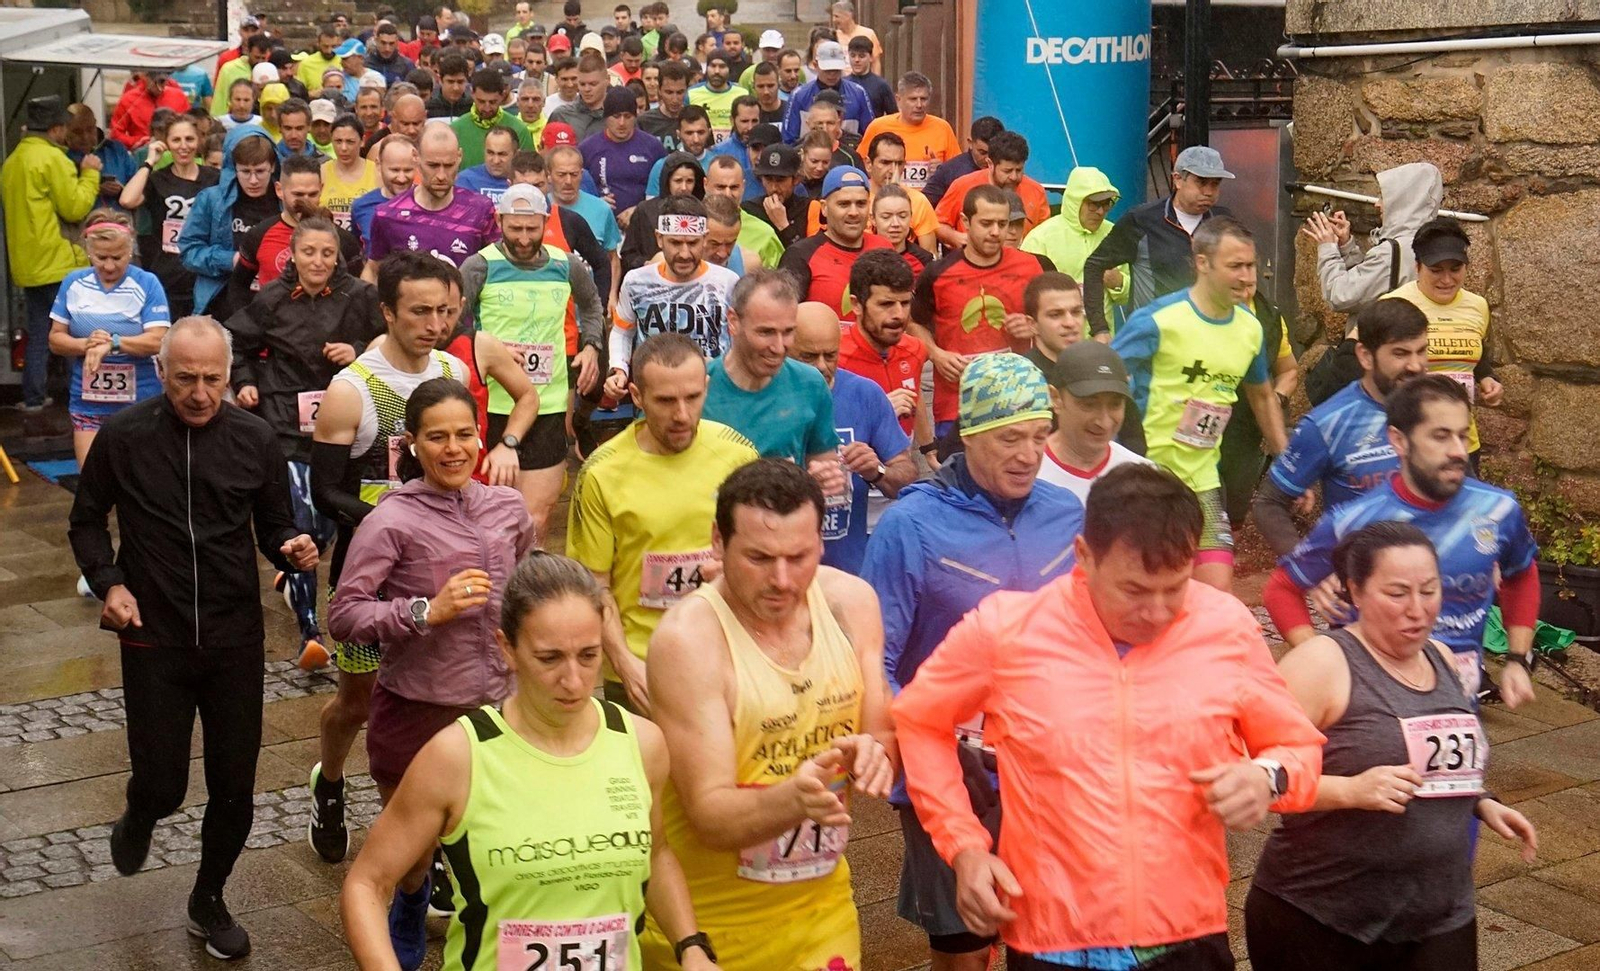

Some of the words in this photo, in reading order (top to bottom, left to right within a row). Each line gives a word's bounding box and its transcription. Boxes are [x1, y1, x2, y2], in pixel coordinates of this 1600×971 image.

[903, 167, 927, 180] 129
[644, 303, 721, 335] ADN
[1428, 347, 1444, 355] San
[90, 372, 127, 390] 253
[666, 565, 704, 592] 44
[1426, 734, 1476, 771] 237
[574, 883, 600, 891] VIGO
[526, 940, 607, 971] 251
